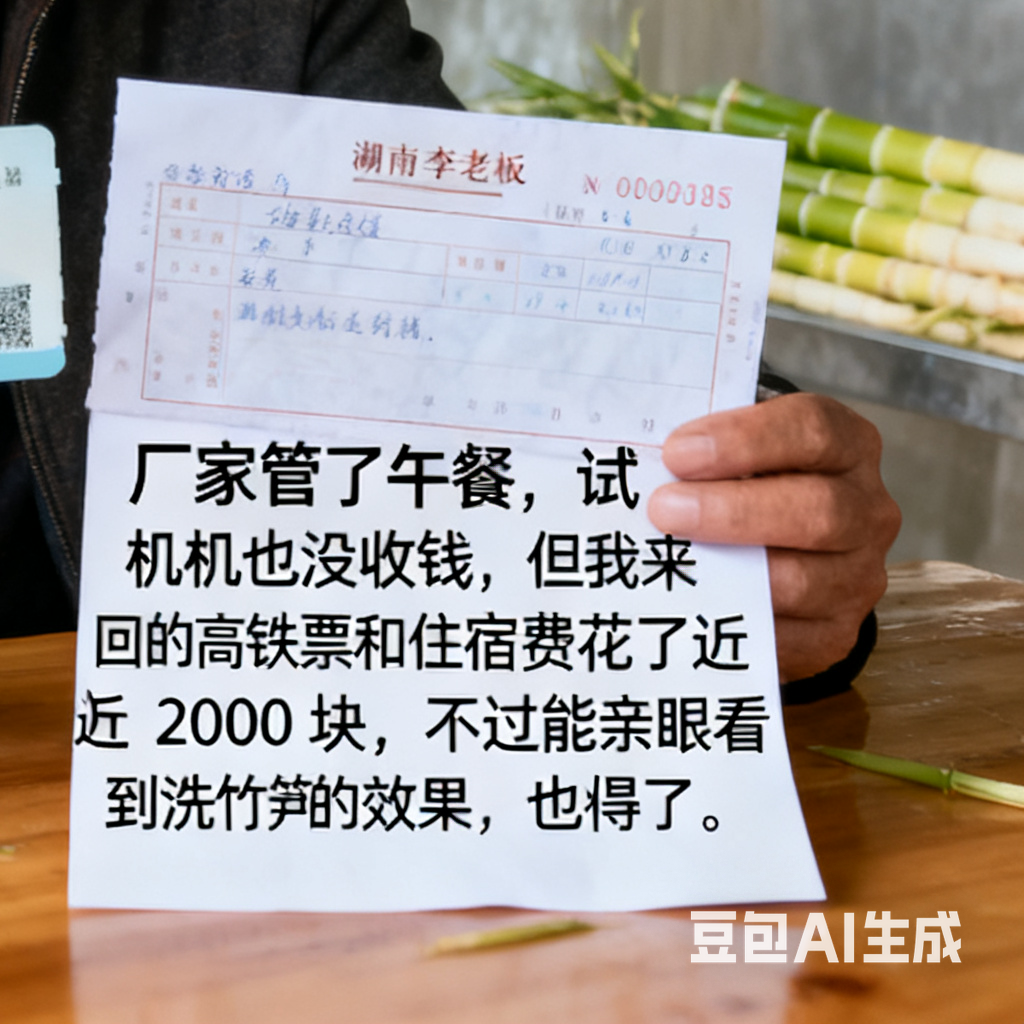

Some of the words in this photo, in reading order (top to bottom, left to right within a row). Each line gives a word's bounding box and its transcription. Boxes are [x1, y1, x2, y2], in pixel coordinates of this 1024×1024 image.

[353, 140, 526, 185] 湖南李老板
[130, 441, 640, 514] 厂家管了午餐，试
[126, 529, 697, 593] 机机也没收钱，但我来
[95, 612, 750, 673] 回的高铁票和住宿费花了近
[156, 697, 293, 747] 2000
[309, 694, 770, 757] 块，不过能亲眼看
[105, 774, 719, 836] 到洗竹笋的效果，也得了。
